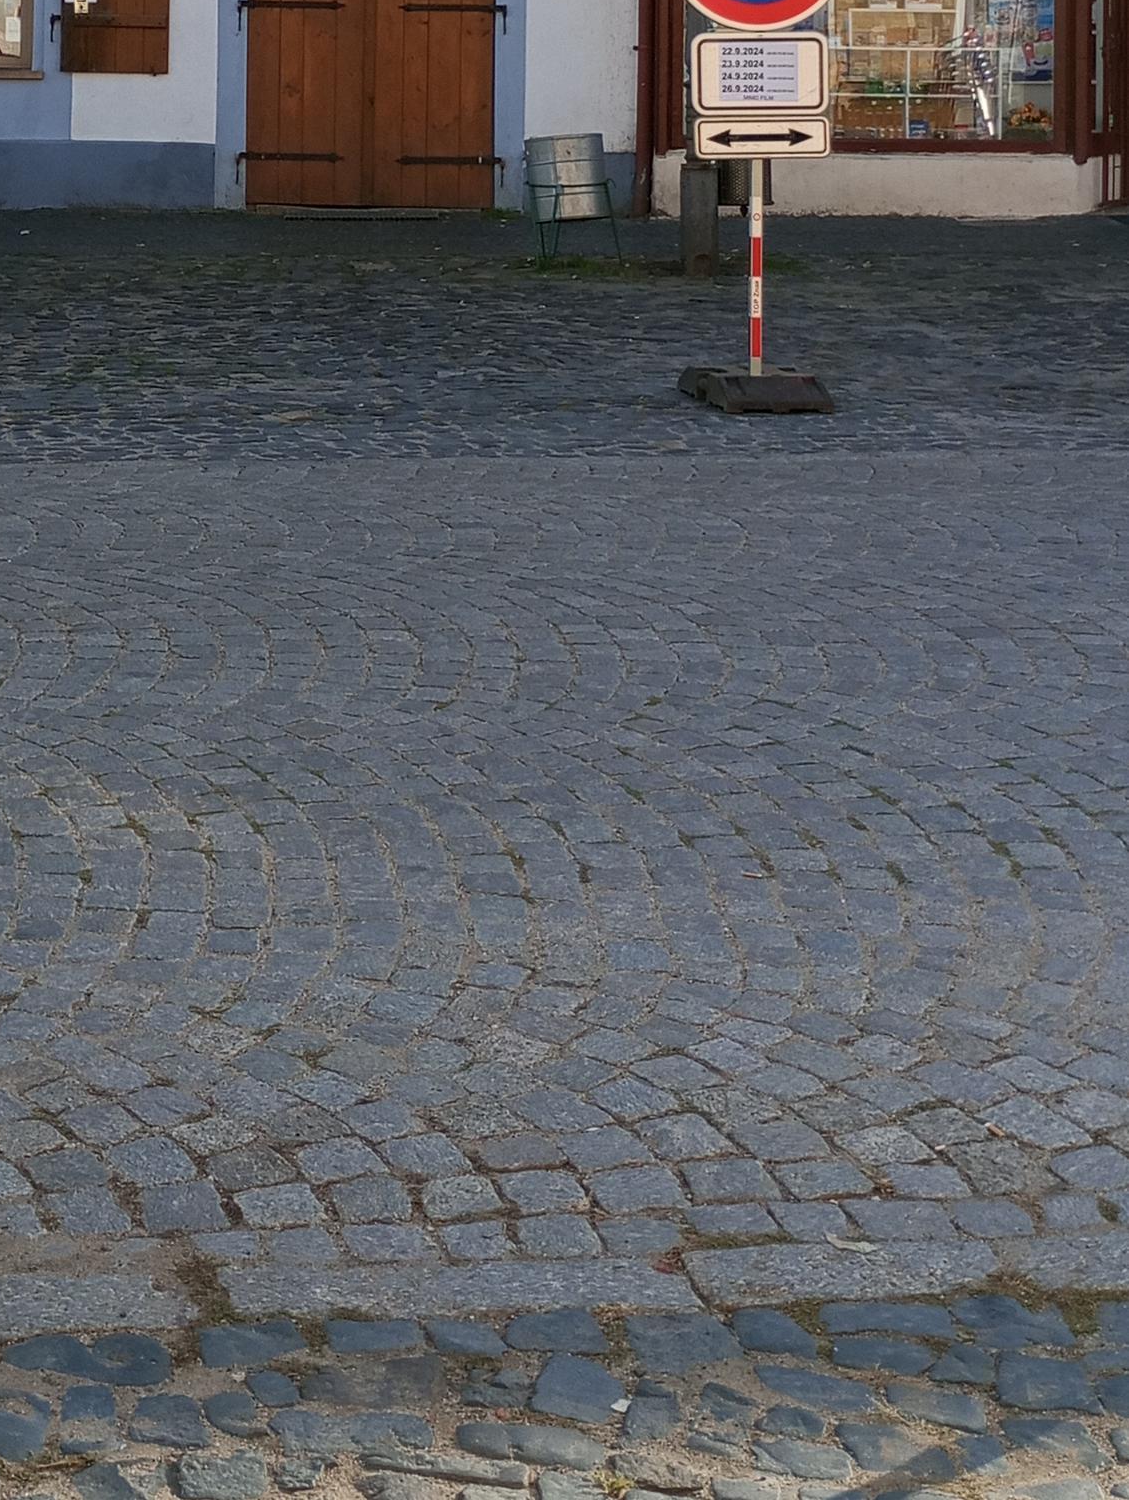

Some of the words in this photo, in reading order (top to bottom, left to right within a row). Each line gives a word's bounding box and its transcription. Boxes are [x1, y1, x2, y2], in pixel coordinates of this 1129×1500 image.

[721, 47, 764, 56] 22.9.2024
[721, 60, 764, 68] 23.9.2024
[721, 72, 764, 81] 24.9.2024
[721, 85, 764, 93] 26.9.2024
